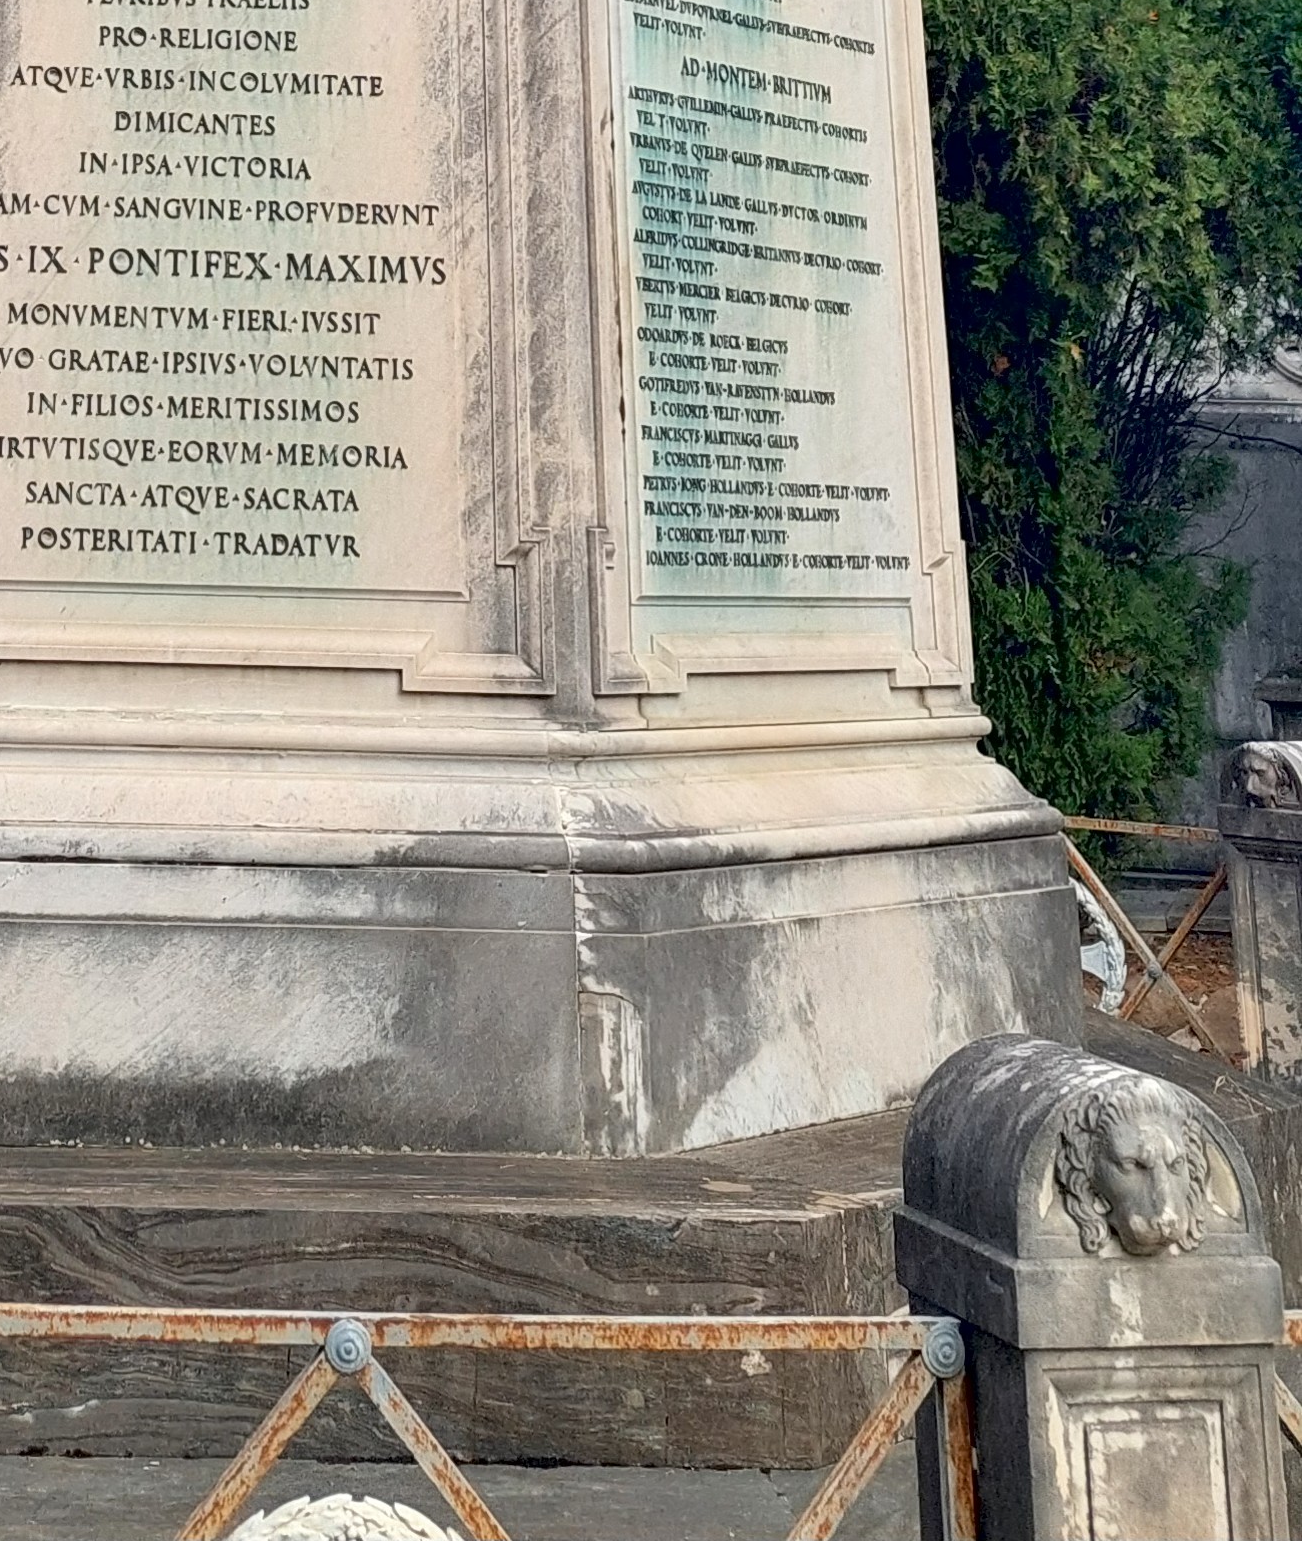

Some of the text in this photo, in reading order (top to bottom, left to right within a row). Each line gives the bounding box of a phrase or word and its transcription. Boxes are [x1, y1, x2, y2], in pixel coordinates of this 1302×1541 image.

[98, 26, 298, 52] PRO RELIGIONE
[10, 65, 383, 96] ATQVE VRBIS INCOLVMITATE
[114, 111, 275, 137] DIMICANTES
[79, 152, 311, 180] IN IPSA VICTORIA
[43, 195, 100, 217] CVM
[114, 196, 243, 221] SANGVINE
[255, 200, 439, 226] PROFVDERVNT
[28, 245, 67, 275] IX
[88, 247, 272, 280] PONTIFEX
[285, 252, 447, 284] MAXIMVS
[7, 303, 381, 335] MONVMENTVM FIERI IVSSIT
[48, 348, 150, 374] GRATAE
[161, 351, 236, 376] IPSIVS
[248, 353, 413, 380] VOLVNTATIS
[27, 392, 359, 423] IN FILIOS MERITISSIMOS
[168, 440, 262, 466] EORVM
[276, 443, 408, 469] MEMORIA
[25, 481, 359, 516] SANCTA ATQVE SACRATA
[20, 526, 360, 558] POSTERITATI TRADATVR
